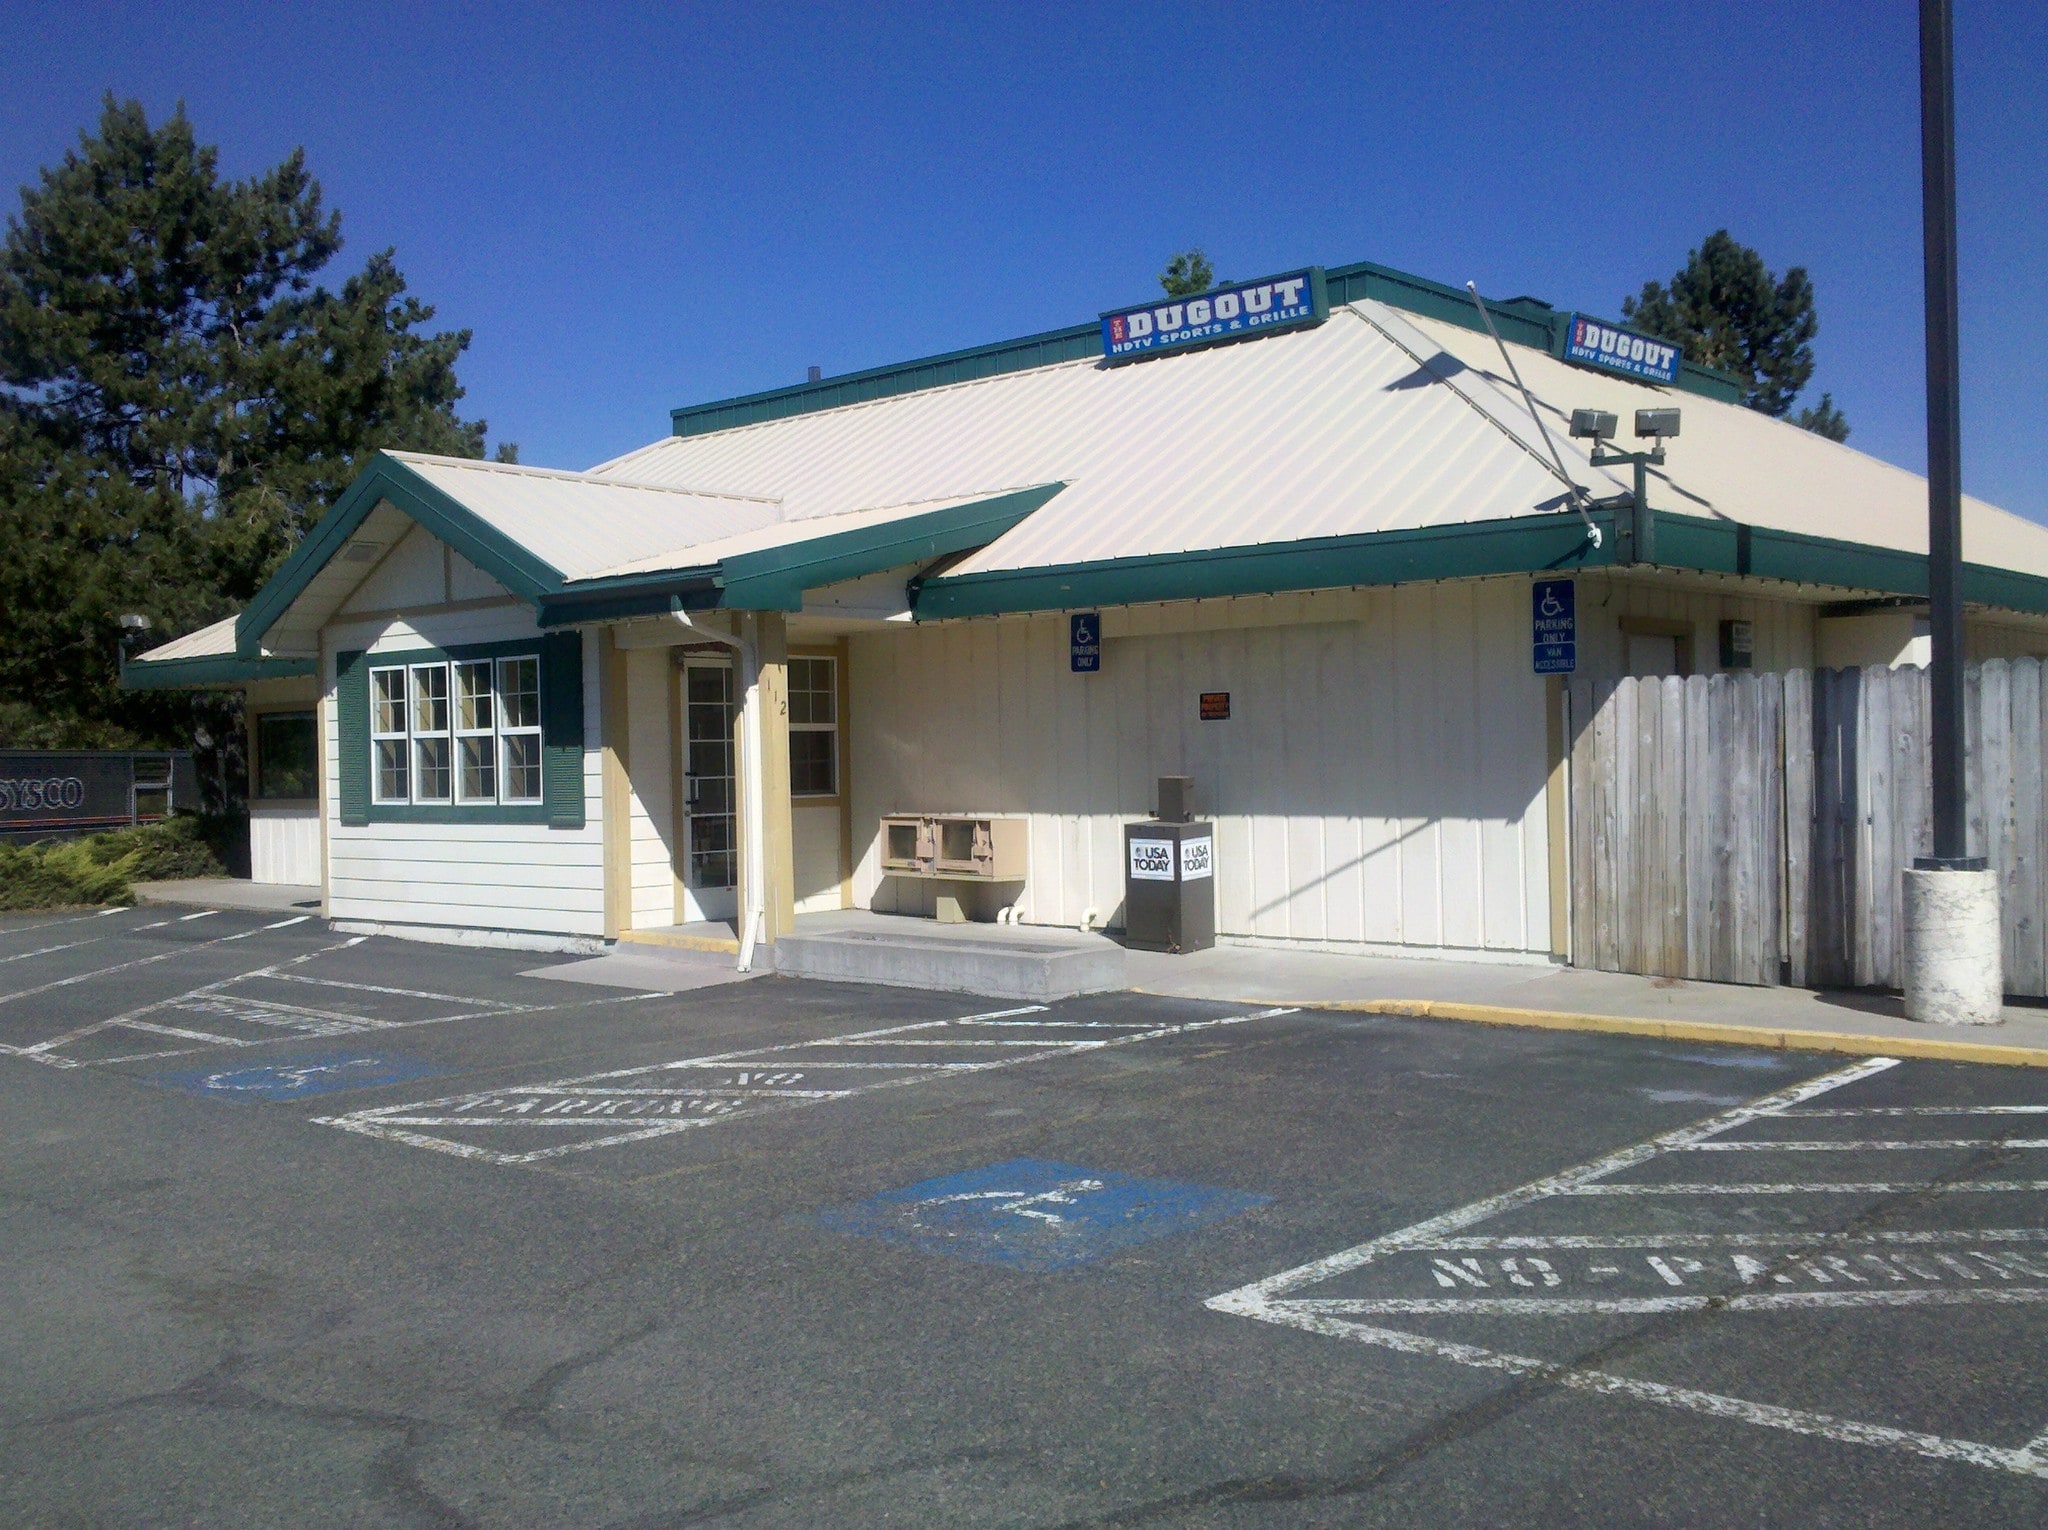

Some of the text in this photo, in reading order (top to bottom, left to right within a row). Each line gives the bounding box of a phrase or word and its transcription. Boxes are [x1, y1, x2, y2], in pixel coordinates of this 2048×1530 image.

[1126, 277, 1304, 339] DUGOUT
[1112, 305, 1309, 353] HDTV SPORTS & GRILLE
[1583, 324, 1675, 370] DUGOUT
[1572, 345, 1672, 381] HDTV SPORTS & GRILLE
[1535, 618, 1573, 630] PARKING
[1543, 633, 1565, 643] ONLY
[1547, 648, 1562, 656] VAN
[1078, 657, 1093, 666] ONLY
[1535, 659, 1574, 669] ACCESSIBLE
[1145, 847, 1169, 859] USA
[1192, 845, 1208, 856] USA
[1134, 859, 1170, 871] TODAY
[1184, 857, 1209, 871] TODAY
